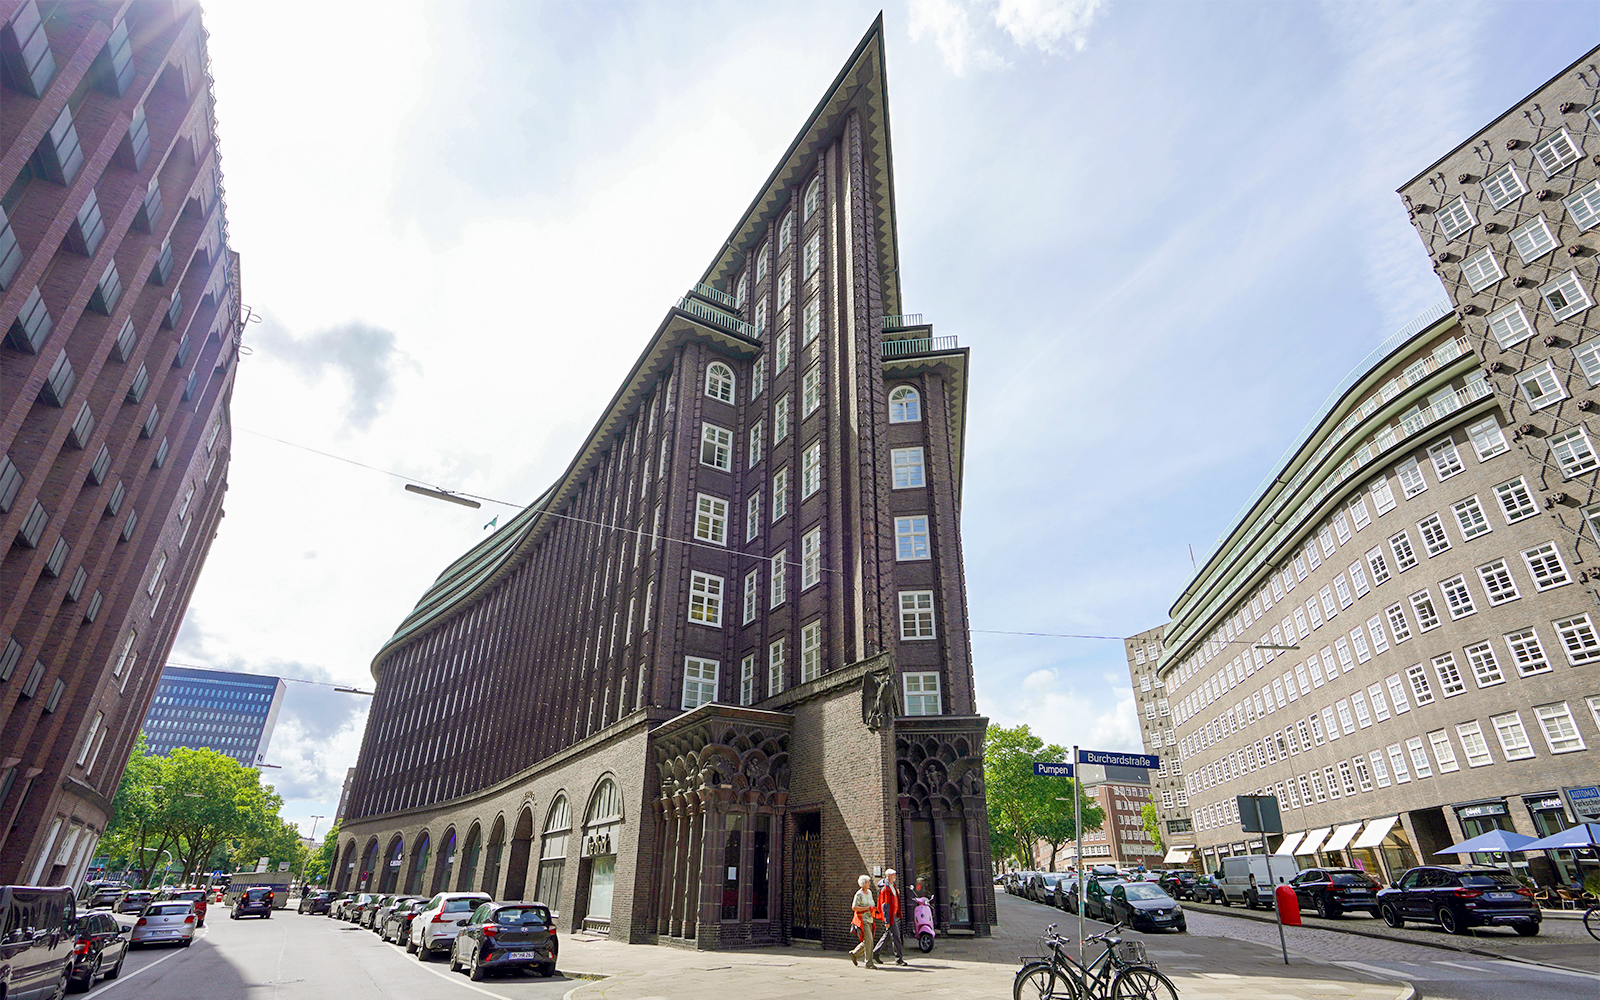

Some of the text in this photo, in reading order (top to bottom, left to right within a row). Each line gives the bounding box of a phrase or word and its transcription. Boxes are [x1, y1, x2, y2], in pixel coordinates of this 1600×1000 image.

[1087, 752, 1151, 767] Burchardstraße
[1038, 764, 1069, 776] Pumpen
[1571, 788, 1598, 799] AUTOMAT
